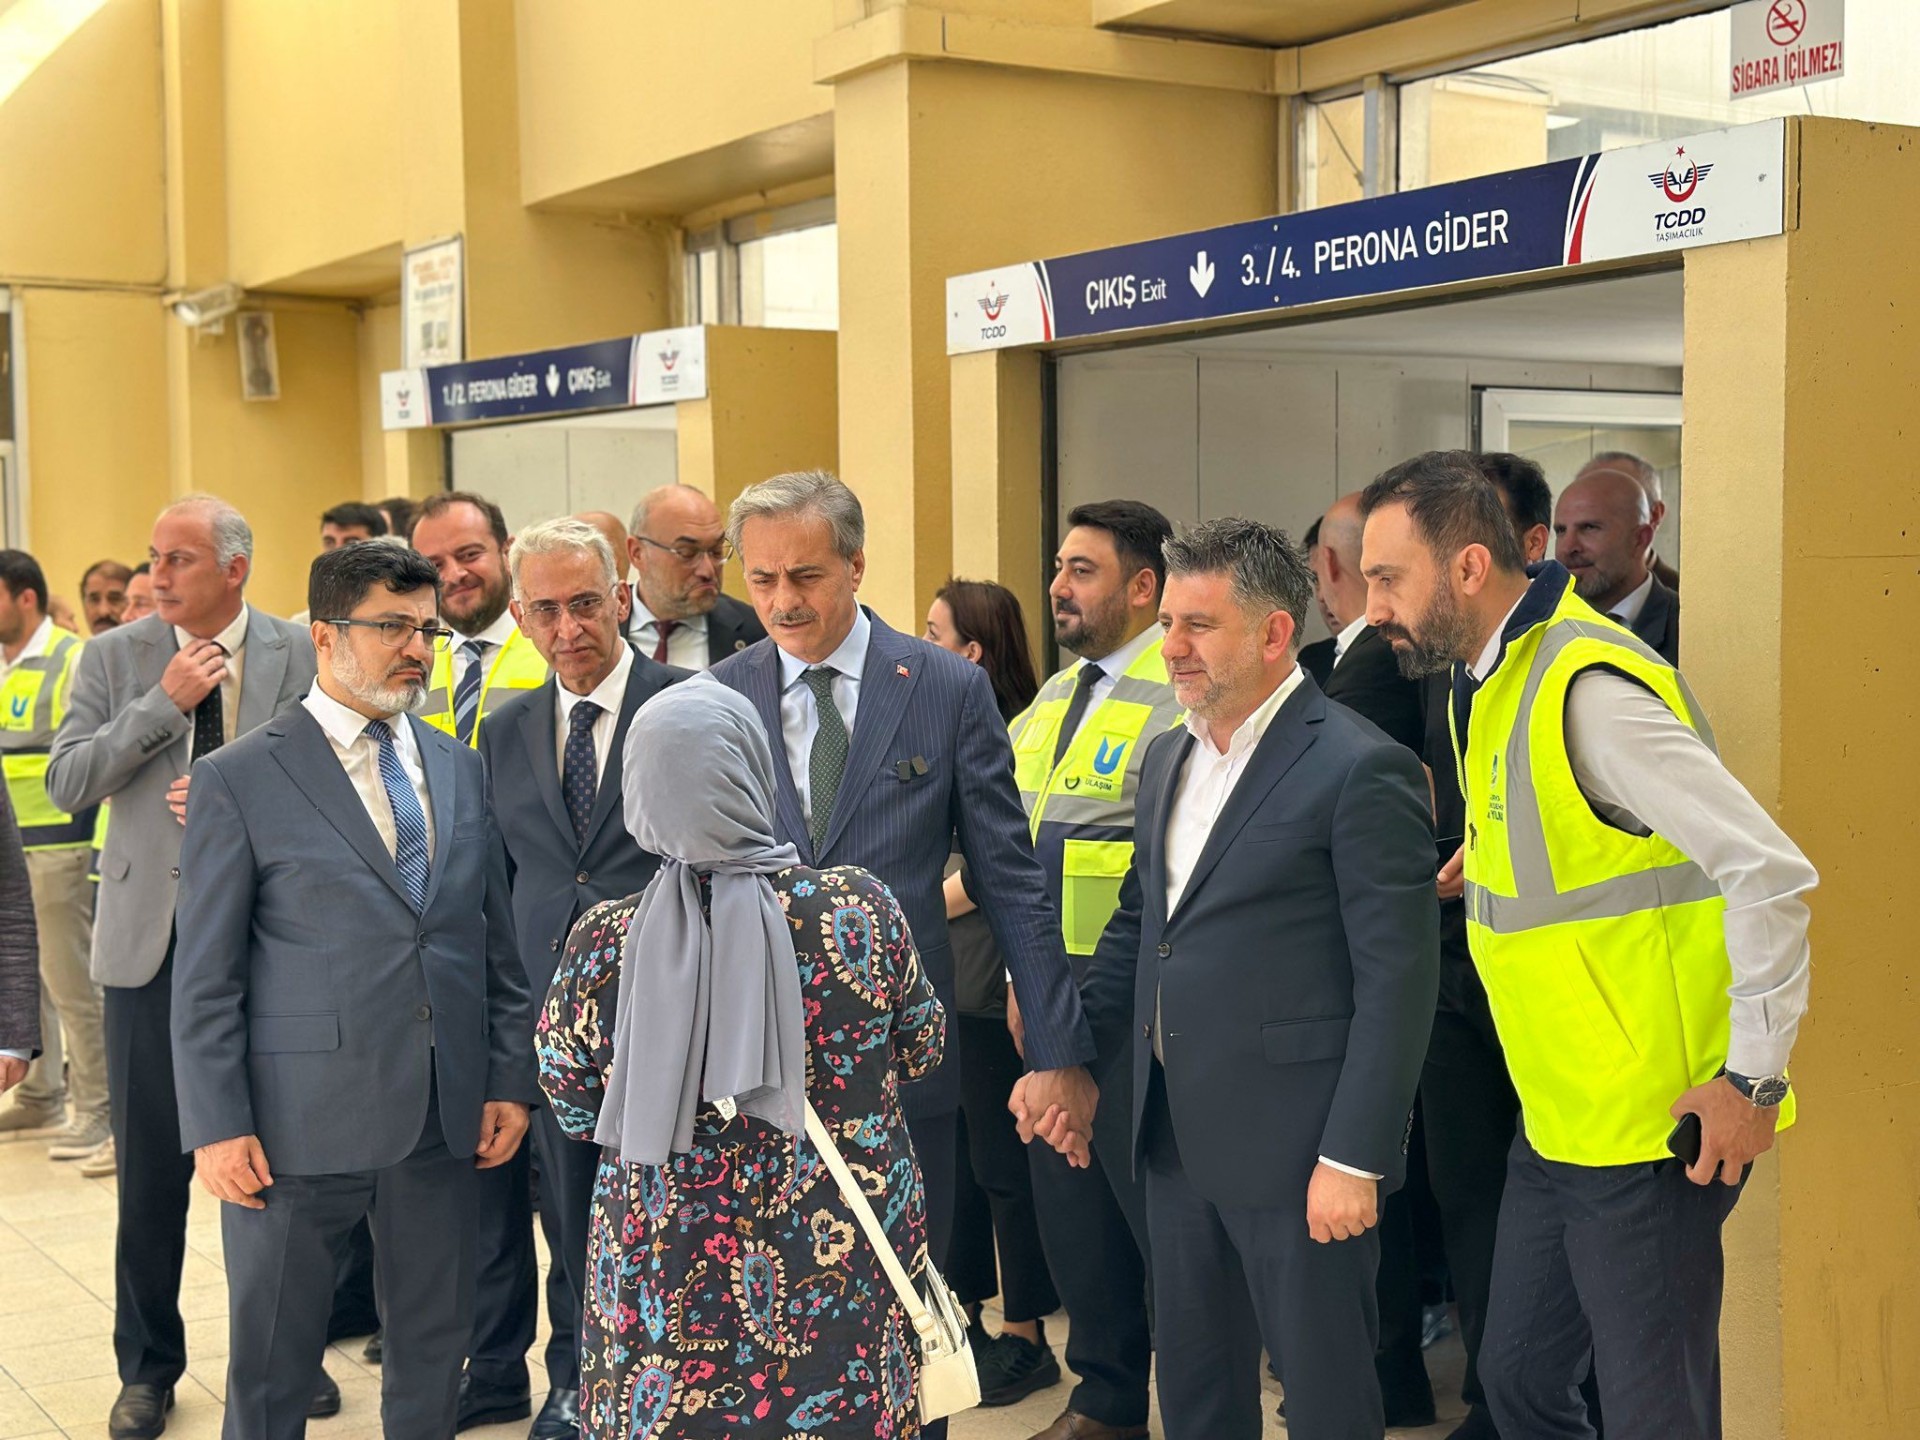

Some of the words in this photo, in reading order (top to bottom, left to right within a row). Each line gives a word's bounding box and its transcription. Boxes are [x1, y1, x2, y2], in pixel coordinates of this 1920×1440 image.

[1732, 57, 1779, 93] SİGARA
[1784, 41, 1842, 87] İÇİLMEZ!
[1654, 207, 1706, 230] TCDD
[1315, 225, 1419, 274] PERONA
[1425, 208, 1509, 256] GİDER
[1656, 227, 1704, 242] TAŞIMACILIK
[1086, 275, 1136, 315] ÇIKIŞ
[1141, 278, 1167, 302] Exit
[981, 324, 1007, 340] TCDD
[468, 378, 507, 403] PERONA
[507, 371, 538, 399] GİDER
[567, 365, 596, 395] ÇIKIŞ
[1085, 777, 1112, 791] ULAŞIM
